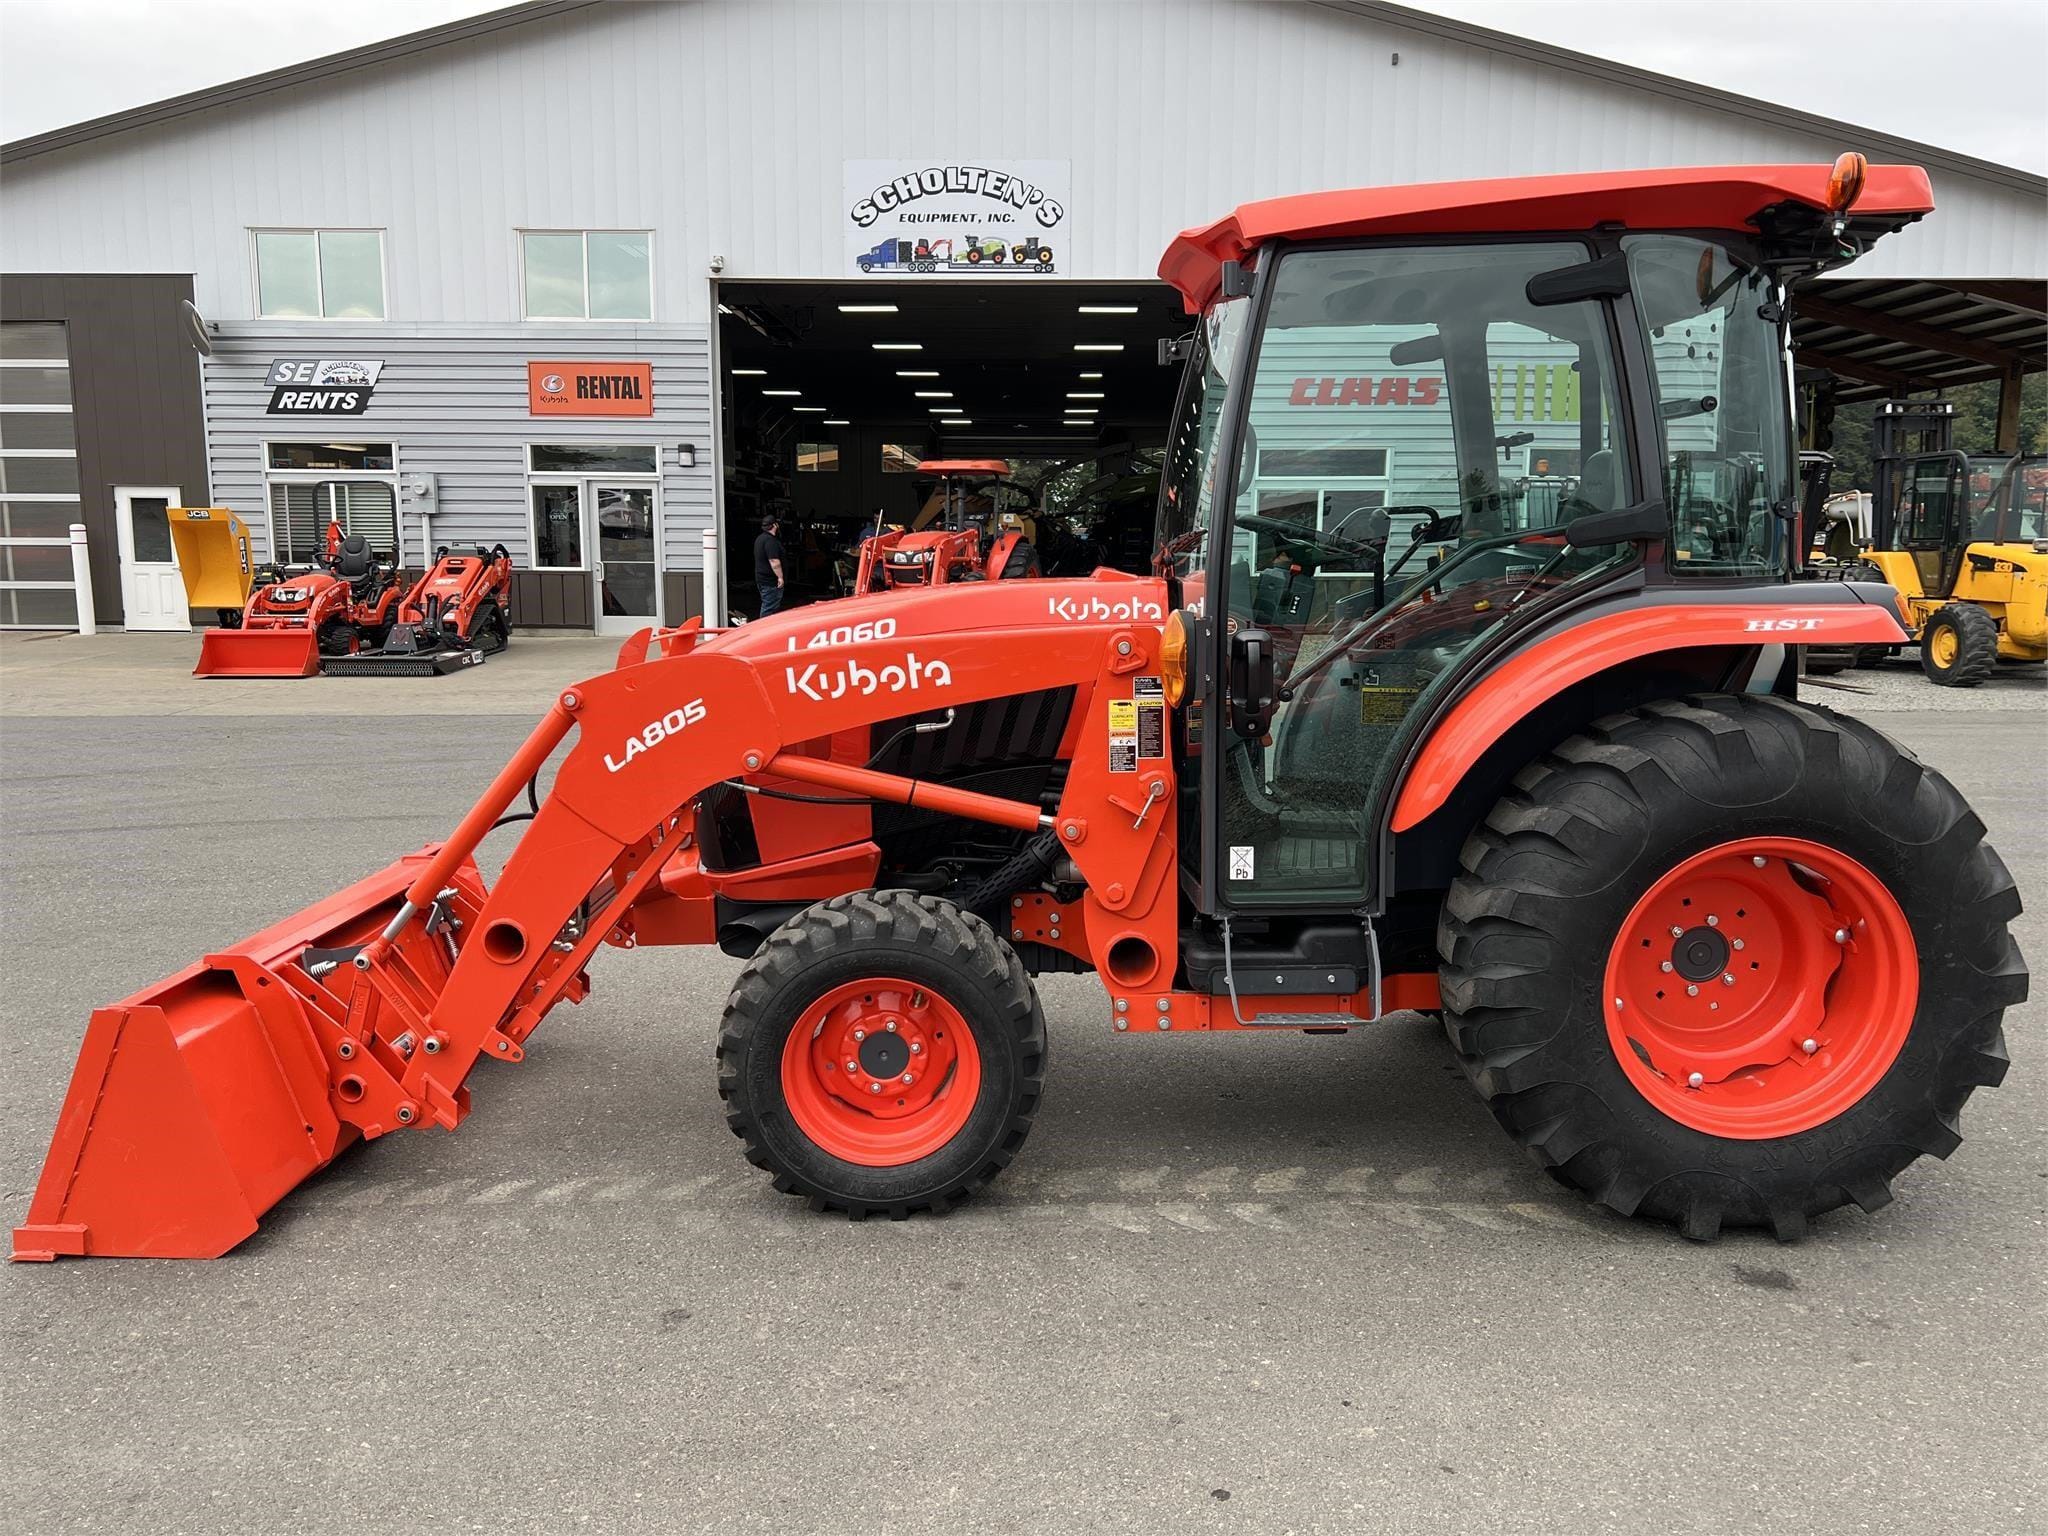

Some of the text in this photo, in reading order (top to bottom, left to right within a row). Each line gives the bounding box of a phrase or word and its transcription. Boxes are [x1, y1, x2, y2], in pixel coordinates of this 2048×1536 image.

[850, 166, 1064, 227] SCHOLTEN'S
[898, 212, 1016, 225] EQUIPMENT, INC.
[274, 362, 316, 382] SE
[576, 376, 643, 400] RENTAL
[1289, 377, 1443, 406] CLAAS
[277, 391, 359, 410] RENTS
[539, 395, 569, 404] Kubota
[1048, 595, 1163, 622] Kubota
[1743, 617, 1825, 633] HST
[785, 651, 953, 702] Kubota
[603, 697, 707, 773] LA805
[1235, 868, 1249, 879] Pb
